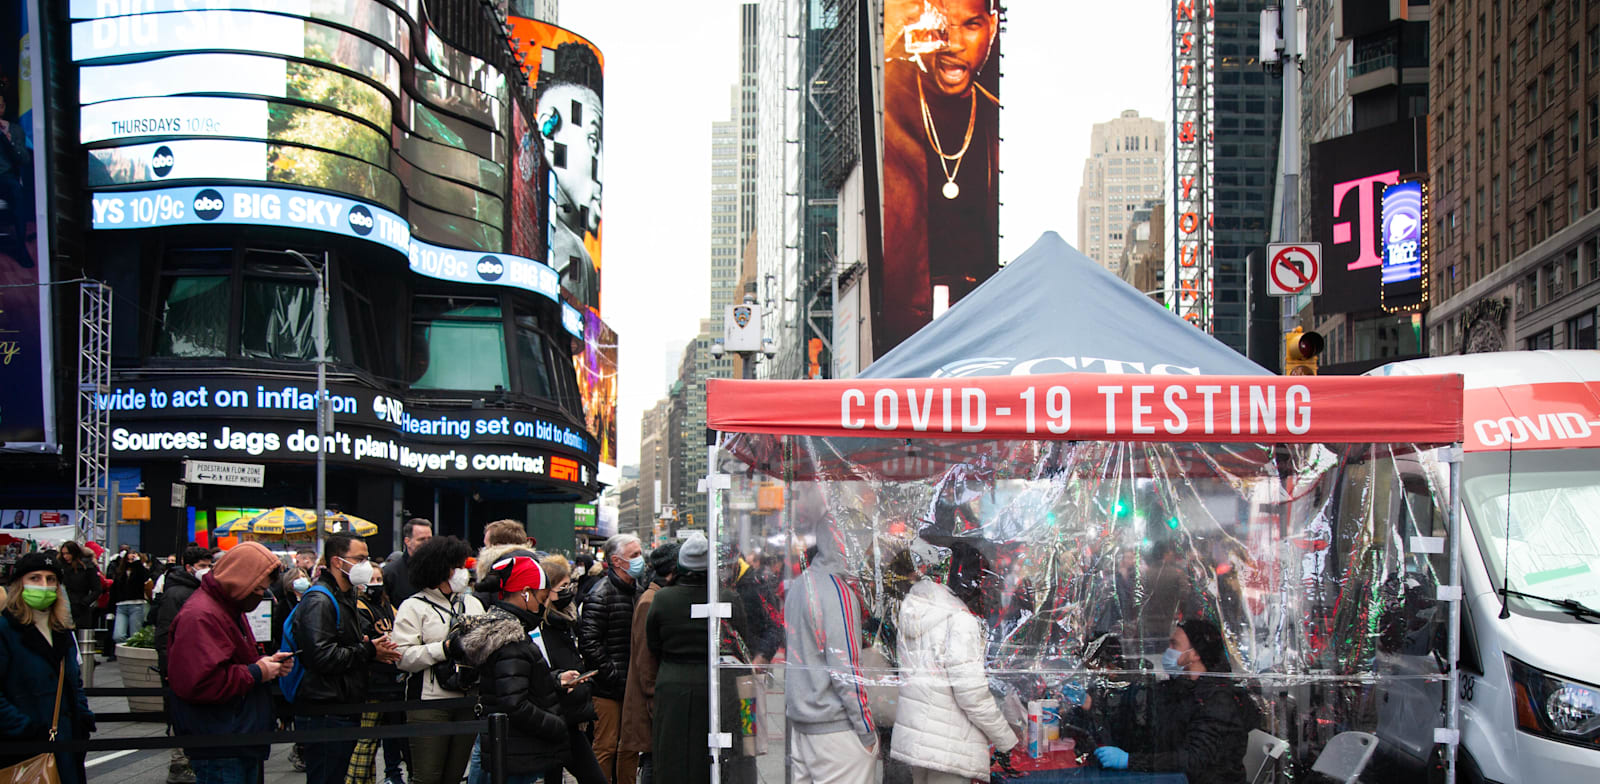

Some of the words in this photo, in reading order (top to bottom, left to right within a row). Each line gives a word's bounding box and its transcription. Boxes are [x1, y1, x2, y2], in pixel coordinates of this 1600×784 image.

[112, 118, 181, 134] THURSDAYS
[153, 155, 174, 168] abc
[92, 198, 124, 223] YS
[130, 194, 185, 224] 10/9c
[194, 197, 223, 211] abc
[233, 192, 281, 220] BIG
[287, 197, 342, 228] SKY
[349, 211, 373, 229] abc
[421, 250, 468, 278] 10/9c
[477, 261, 503, 275] abc
[510, 261, 538, 287] BIG
[150, 388, 167, 409] to
[172, 386, 208, 408] act
[214, 389, 249, 408] on
[840, 386, 1072, 435] COVID-19
[1097, 384, 1312, 436] TESTING
[402, 412, 471, 439] Hearing
[475, 416, 509, 435] set
[513, 421, 534, 438] on
[536, 419, 552, 441] bid
[553, 425, 563, 443] to
[1473, 412, 1600, 447] COVID-
[112, 427, 207, 451] Sources:
[214, 427, 280, 455] Jags
[286, 429, 351, 455] don't
[355, 434, 388, 460] plan
[197, 464, 230, 473] PEDESTRIAN
[231, 466, 246, 474] FLOW
[400, 446, 468, 473] Meyer's
[472, 450, 545, 474] contract
[225, 474, 239, 482] KEEP
[1459, 672, 1475, 702] 38
